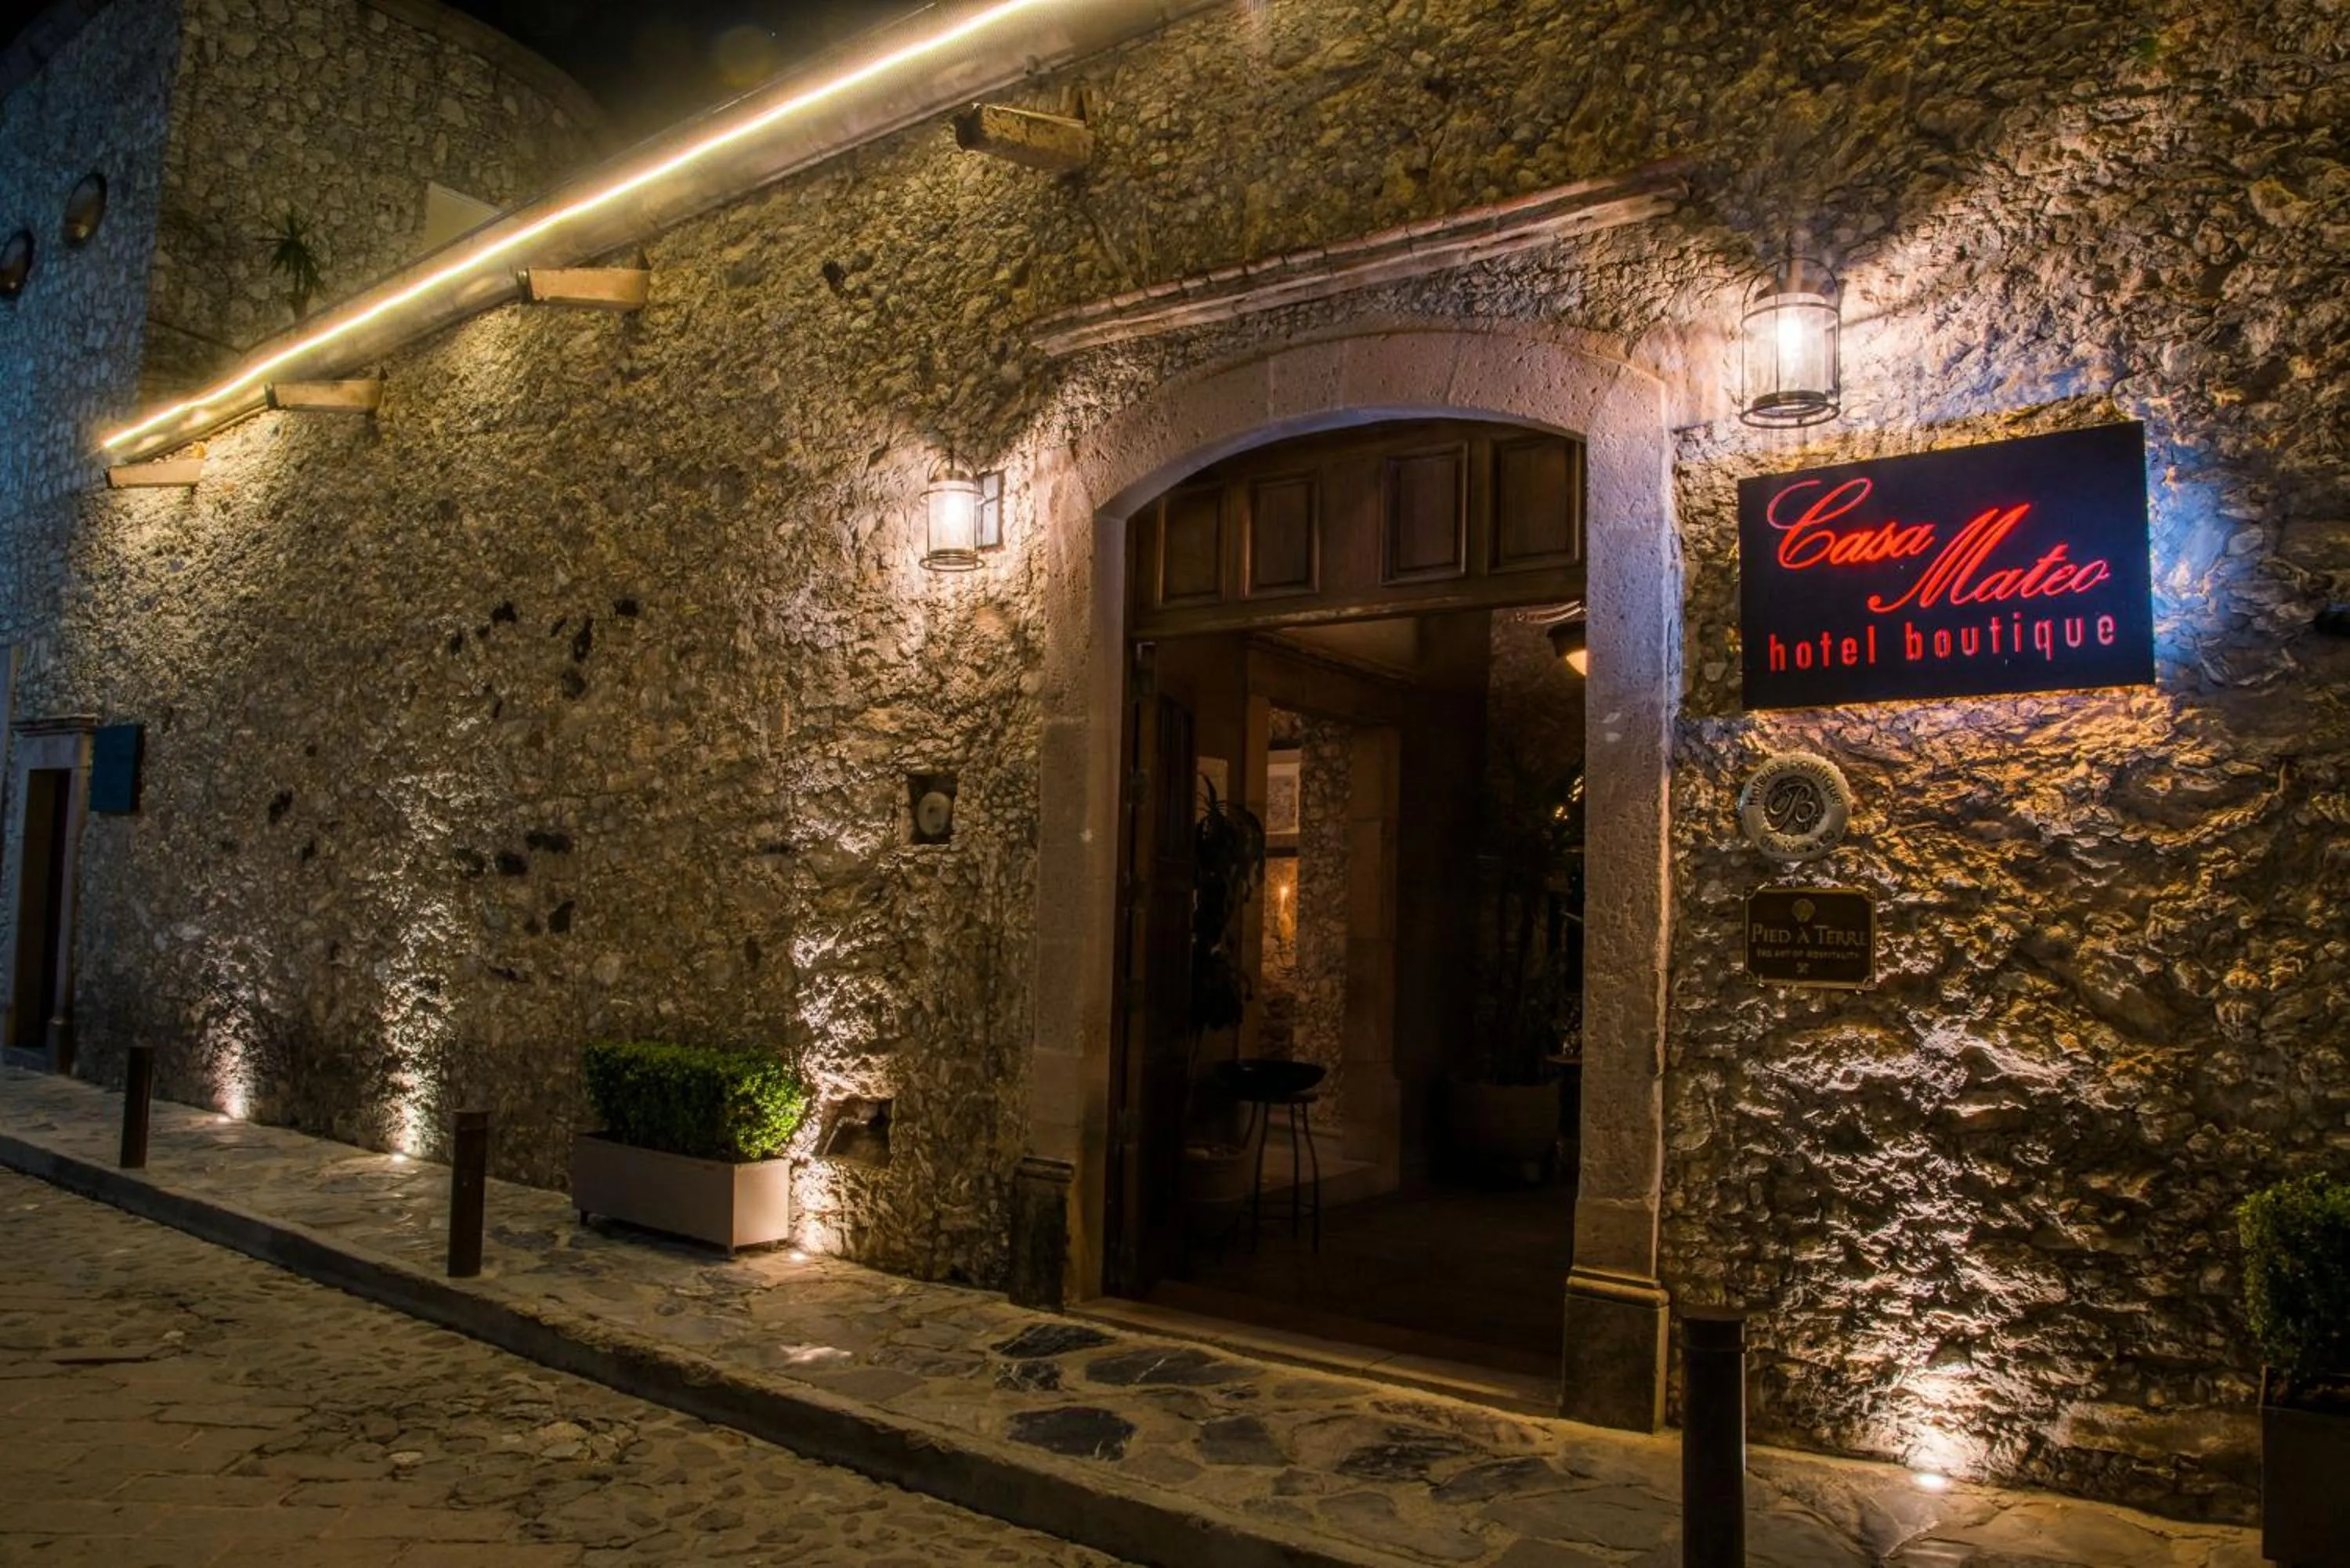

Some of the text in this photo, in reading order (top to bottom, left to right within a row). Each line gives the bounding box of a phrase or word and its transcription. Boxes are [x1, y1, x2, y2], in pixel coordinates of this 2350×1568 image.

[1766, 477, 2111, 613] Casa Mateo
[1769, 611, 2116, 673] hotel boutique
